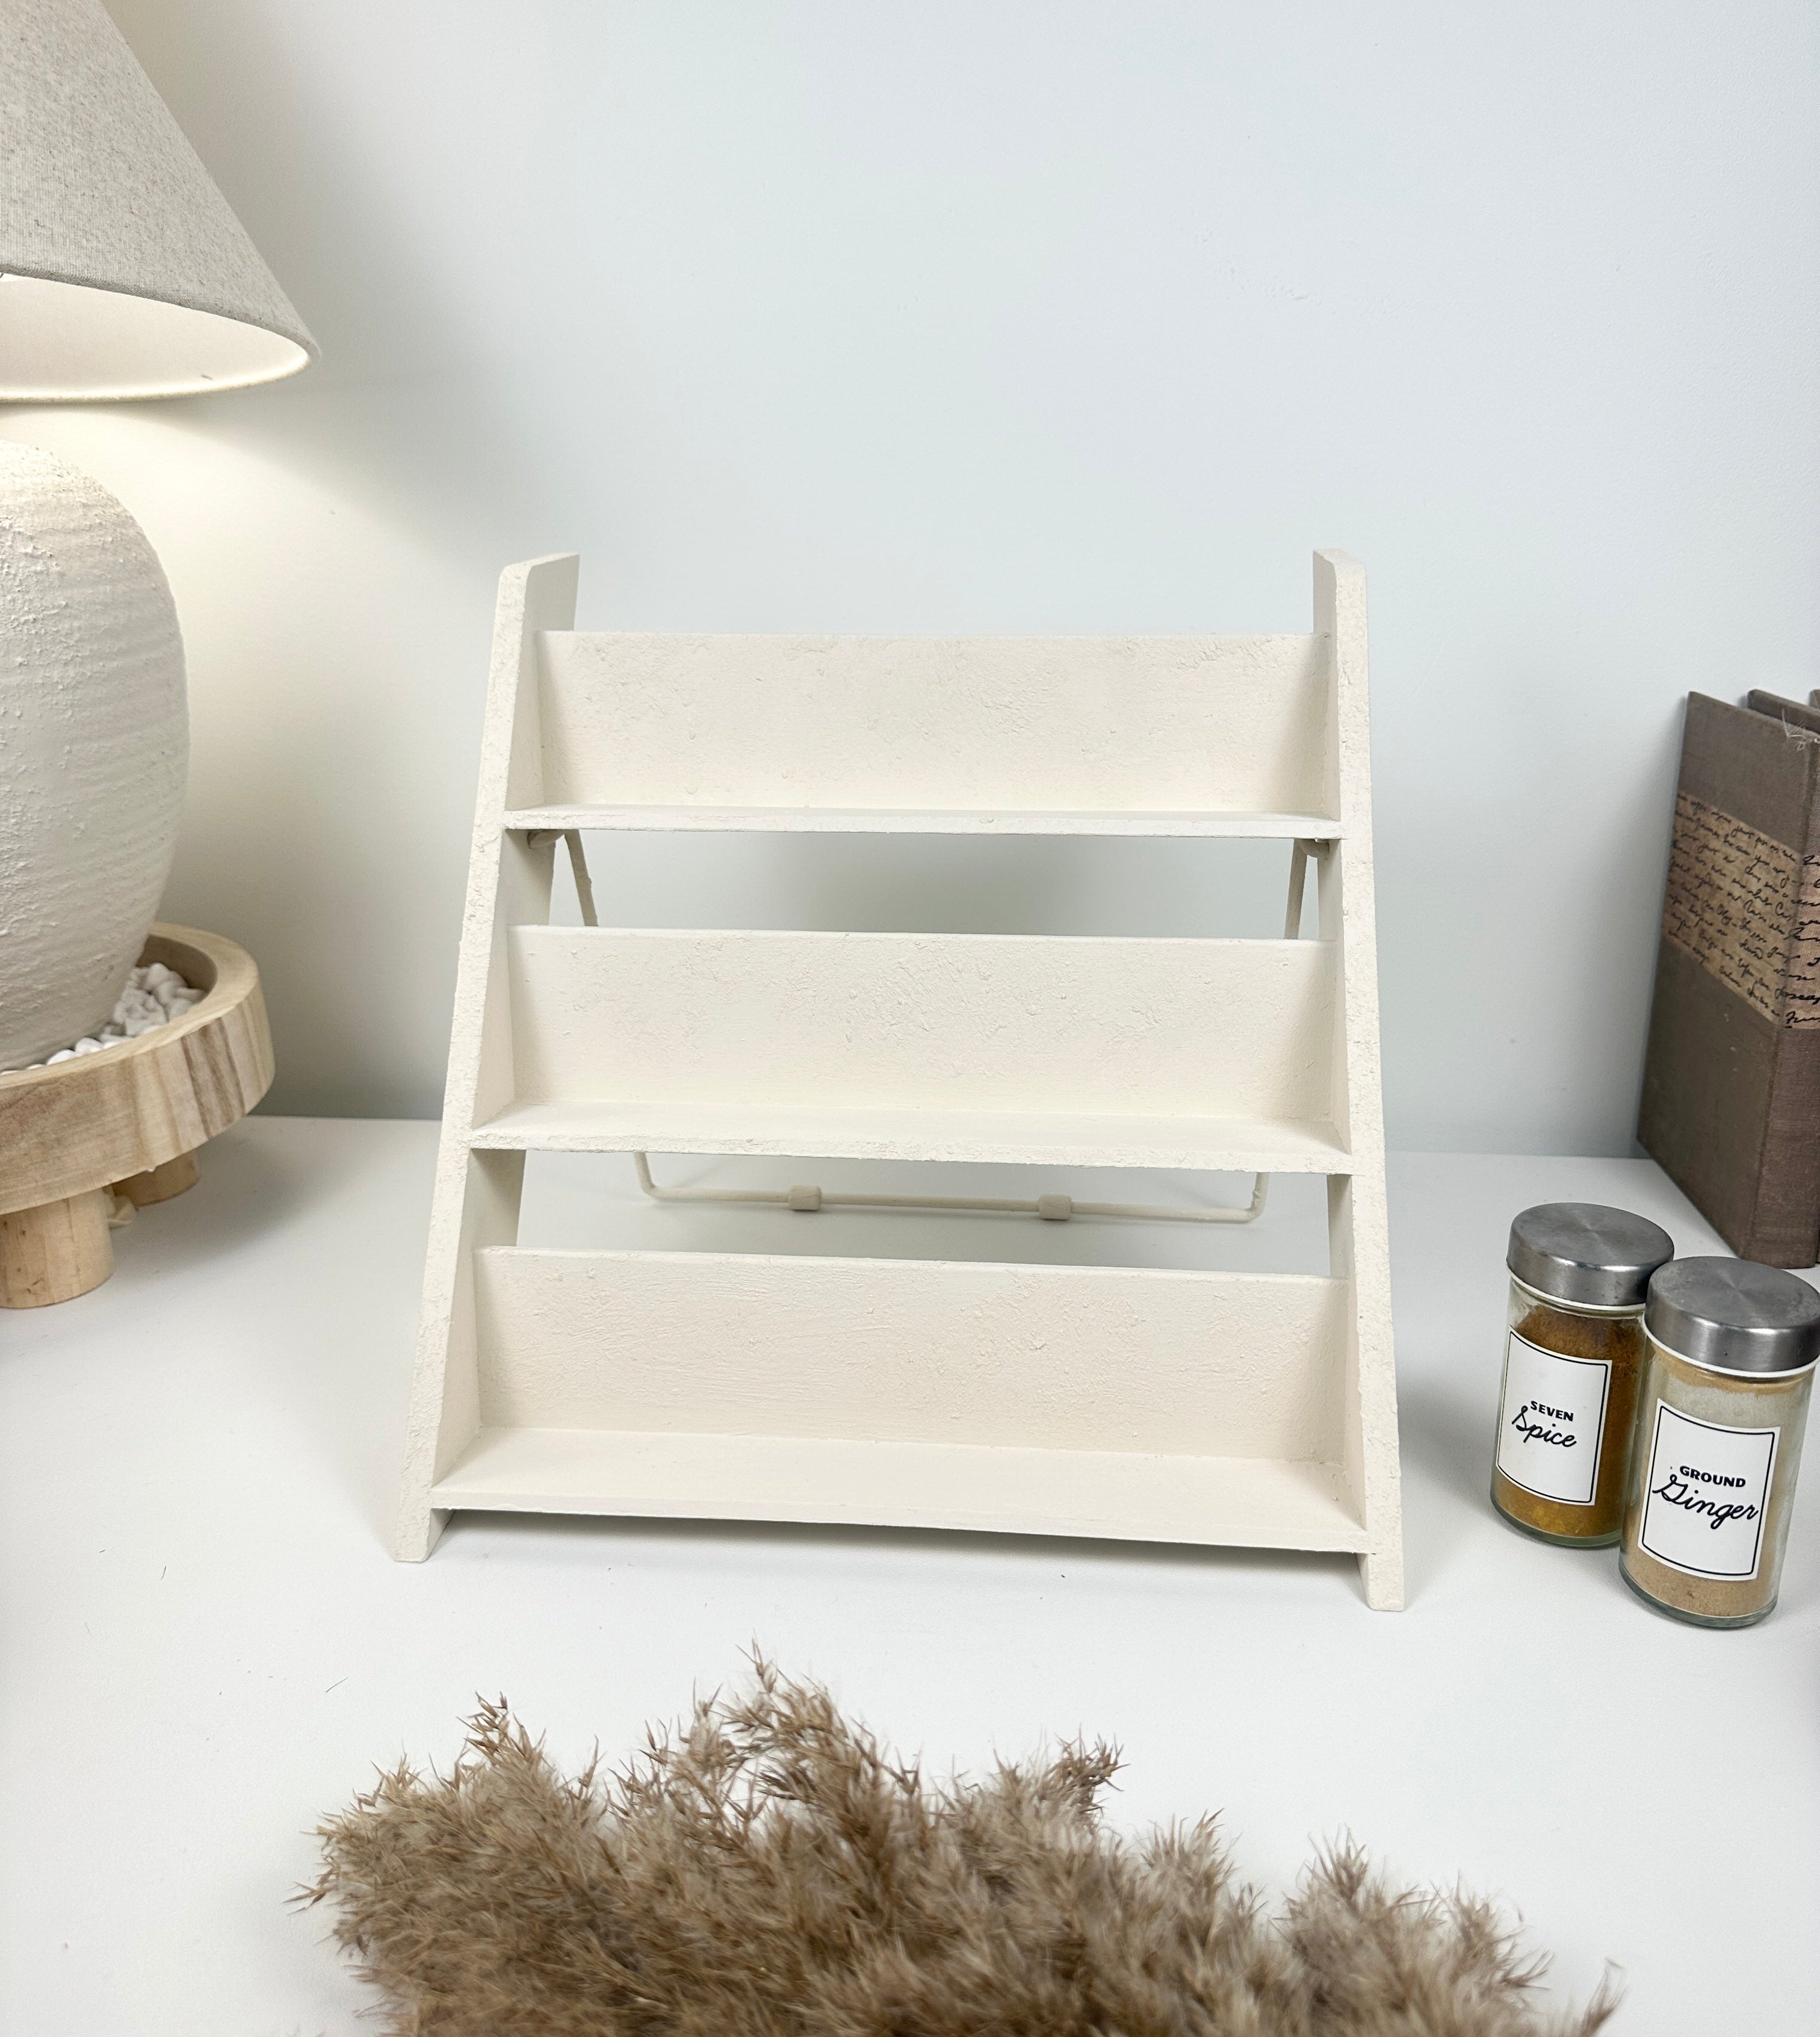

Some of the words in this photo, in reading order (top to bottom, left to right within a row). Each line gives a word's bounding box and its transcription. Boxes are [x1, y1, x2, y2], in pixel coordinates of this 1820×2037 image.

[1511, 1405, 1577, 1447] Spice
[1530, 1400, 1574, 1422] SEVEN
[1679, 1465, 1746, 1487] GROUND
[1652, 1474, 1759, 1529] Ginger
